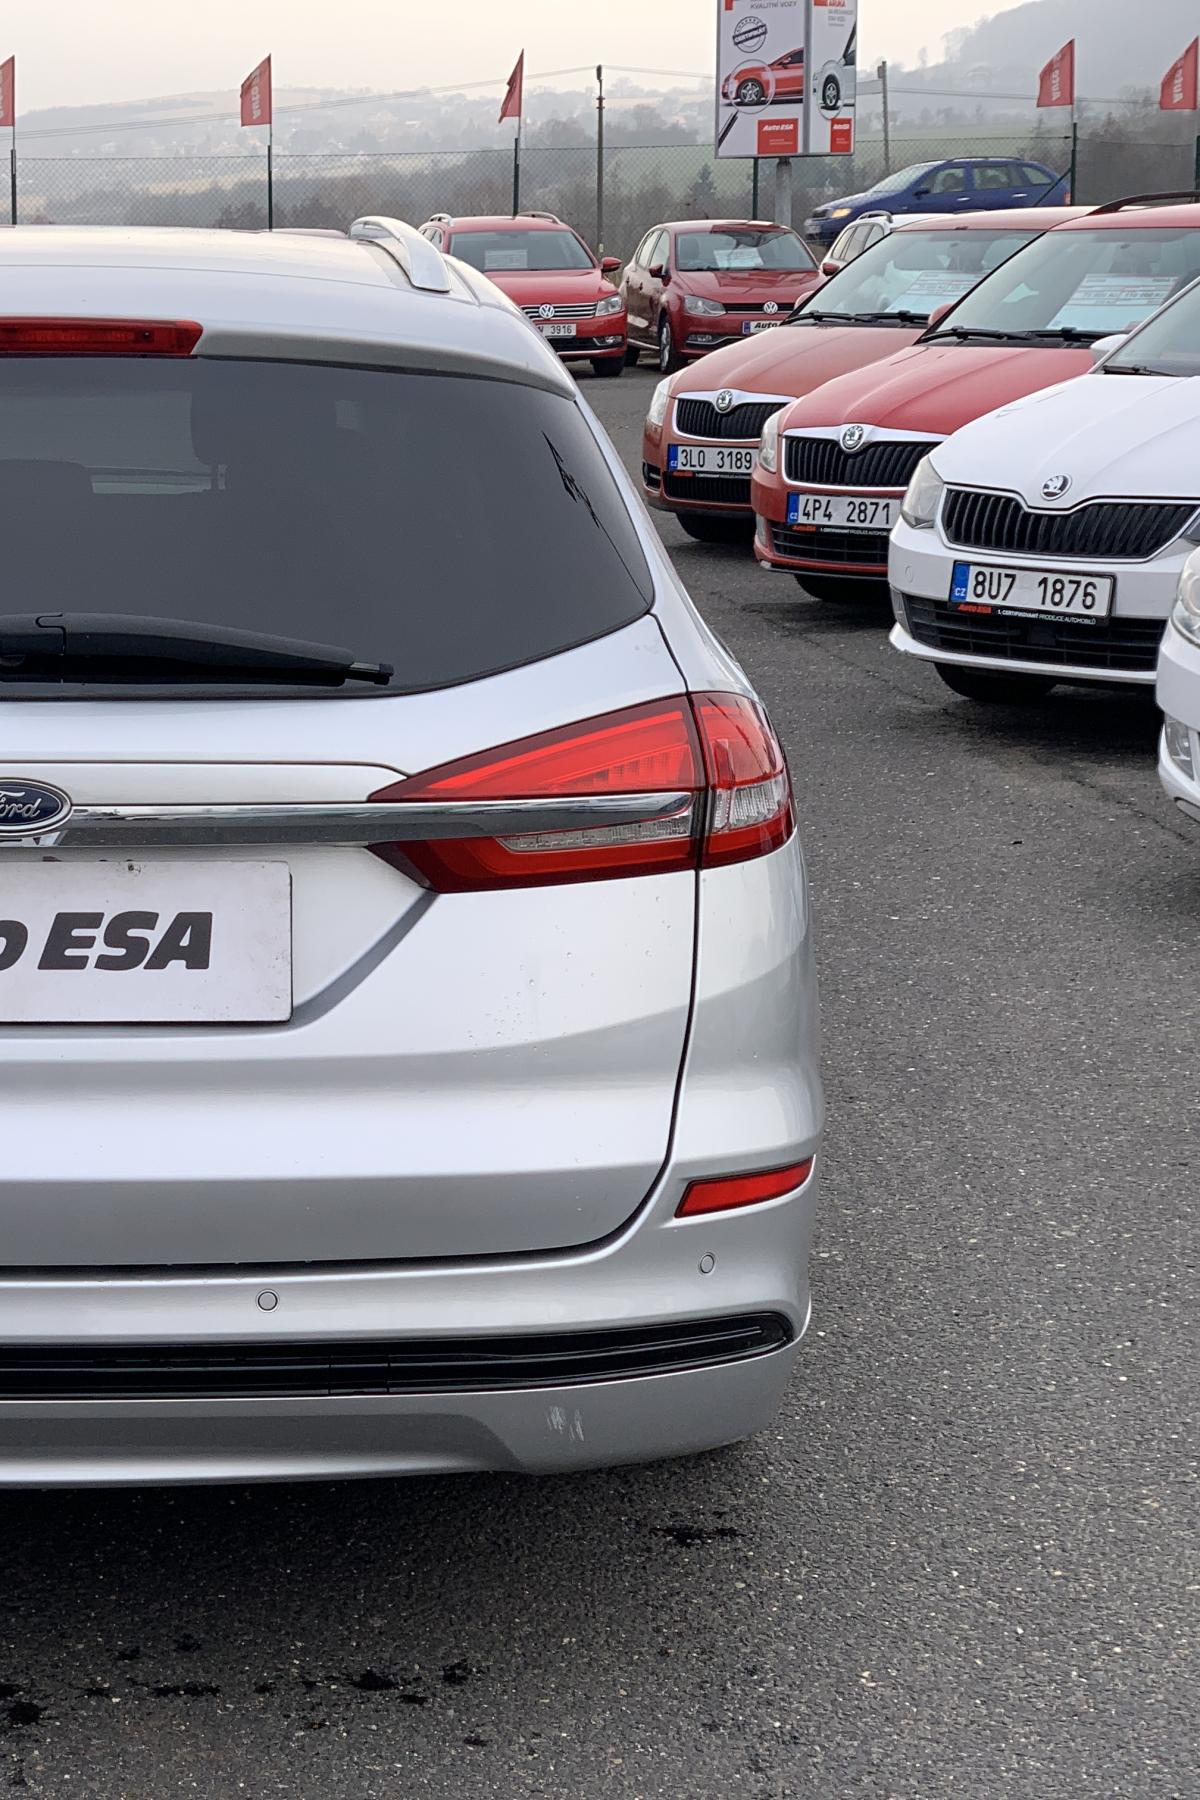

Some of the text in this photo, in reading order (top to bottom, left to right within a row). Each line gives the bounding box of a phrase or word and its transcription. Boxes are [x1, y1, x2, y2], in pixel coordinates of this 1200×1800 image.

[551, 325, 572, 334] 3916
[681, 449, 752, 470] 3L0 3189
[802, 498, 890, 525] 4P4 2871
[955, 587, 965, 596] CZ
[973, 570, 1097, 610] 8U7 1876
[37, 911, 213, 971] ESA
